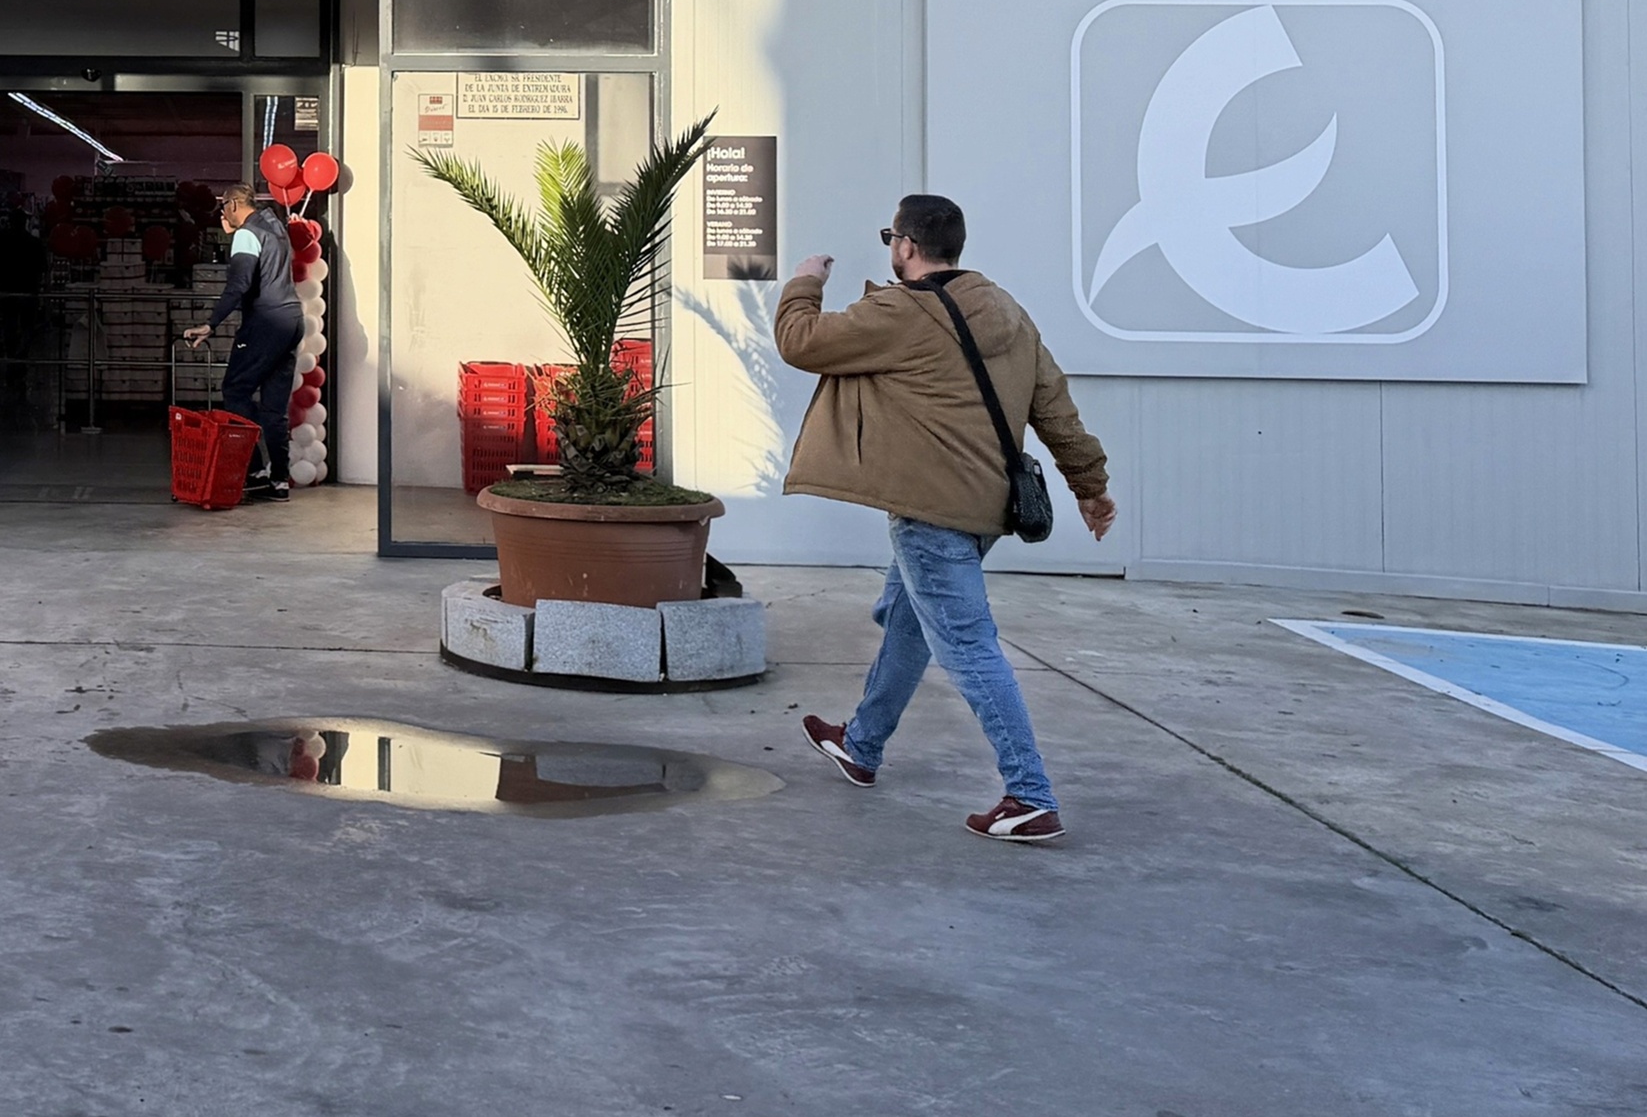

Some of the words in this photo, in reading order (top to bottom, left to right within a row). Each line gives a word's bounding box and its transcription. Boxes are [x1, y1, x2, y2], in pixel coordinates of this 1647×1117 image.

[465, 84, 474, 92] DE
[476, 84, 485, 92] LA
[487, 84, 509, 92] JUNTA
[511, 84, 520, 92] DE
[522, 84, 572, 93] EXTREMADURA
[470, 94, 486, 102] JUAN
[488, 94, 512, 103] CARLOS
[468, 104, 476, 113] EL
[500, 104, 509, 113] DE
[511, 104, 541, 113] FEBRERO
[542, 105, 551, 113] DE
[707, 147, 745, 161] ¡Hola!
[706, 163, 740, 173] Horario
[740, 163, 754, 173] de
